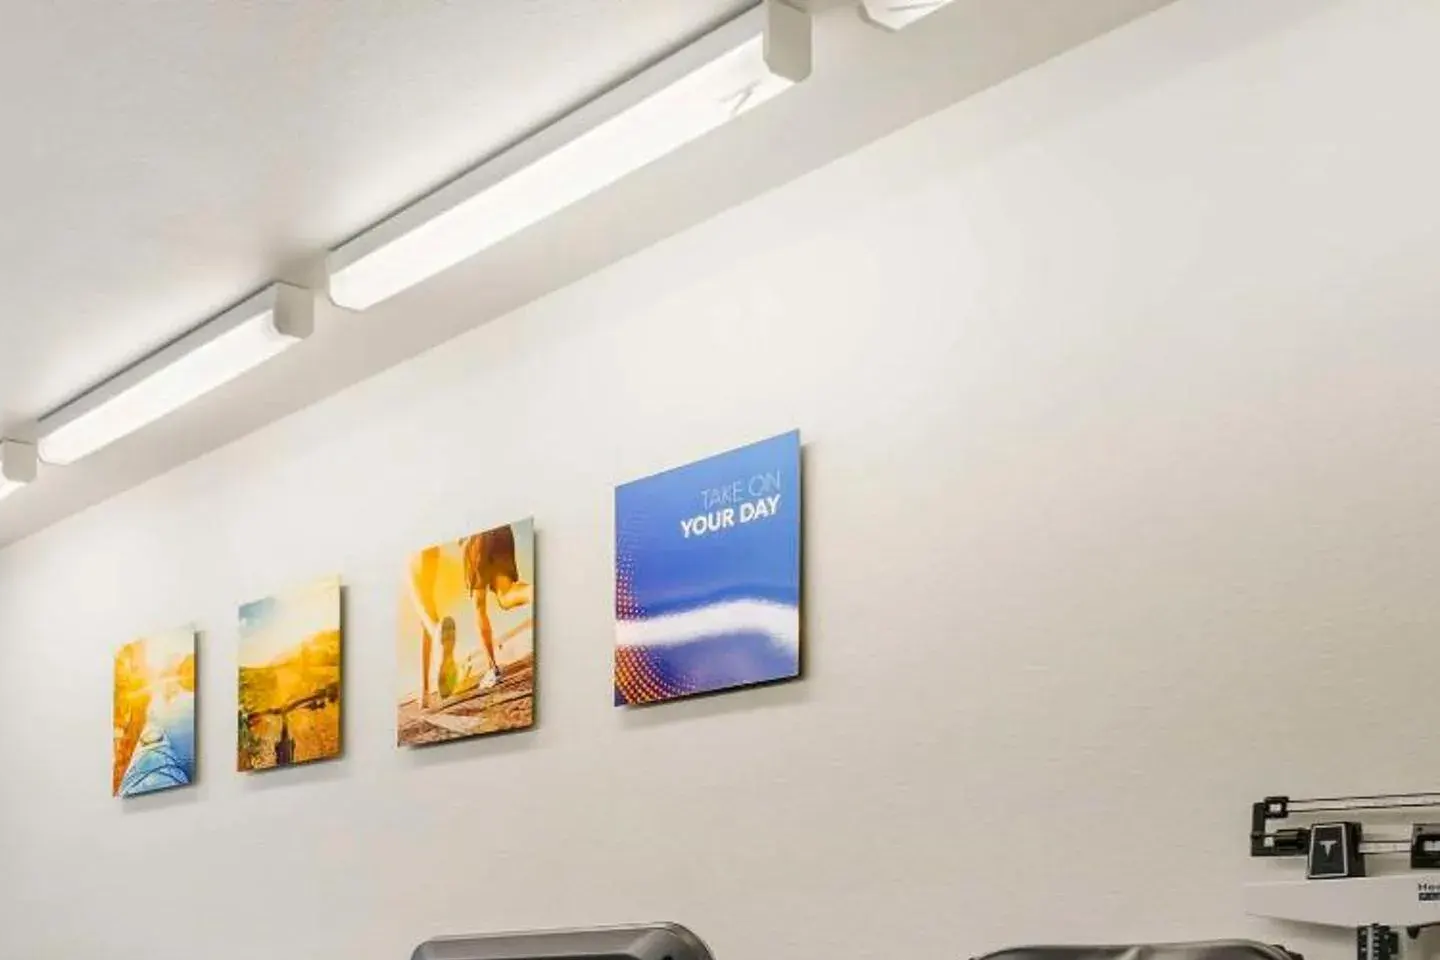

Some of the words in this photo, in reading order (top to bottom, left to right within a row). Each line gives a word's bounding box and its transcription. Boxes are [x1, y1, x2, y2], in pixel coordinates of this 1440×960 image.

[700, 480, 744, 511] TAKE
[747, 468, 781, 497] ON
[680, 510, 735, 538] YOUR
[740, 493, 781, 523] DAY
